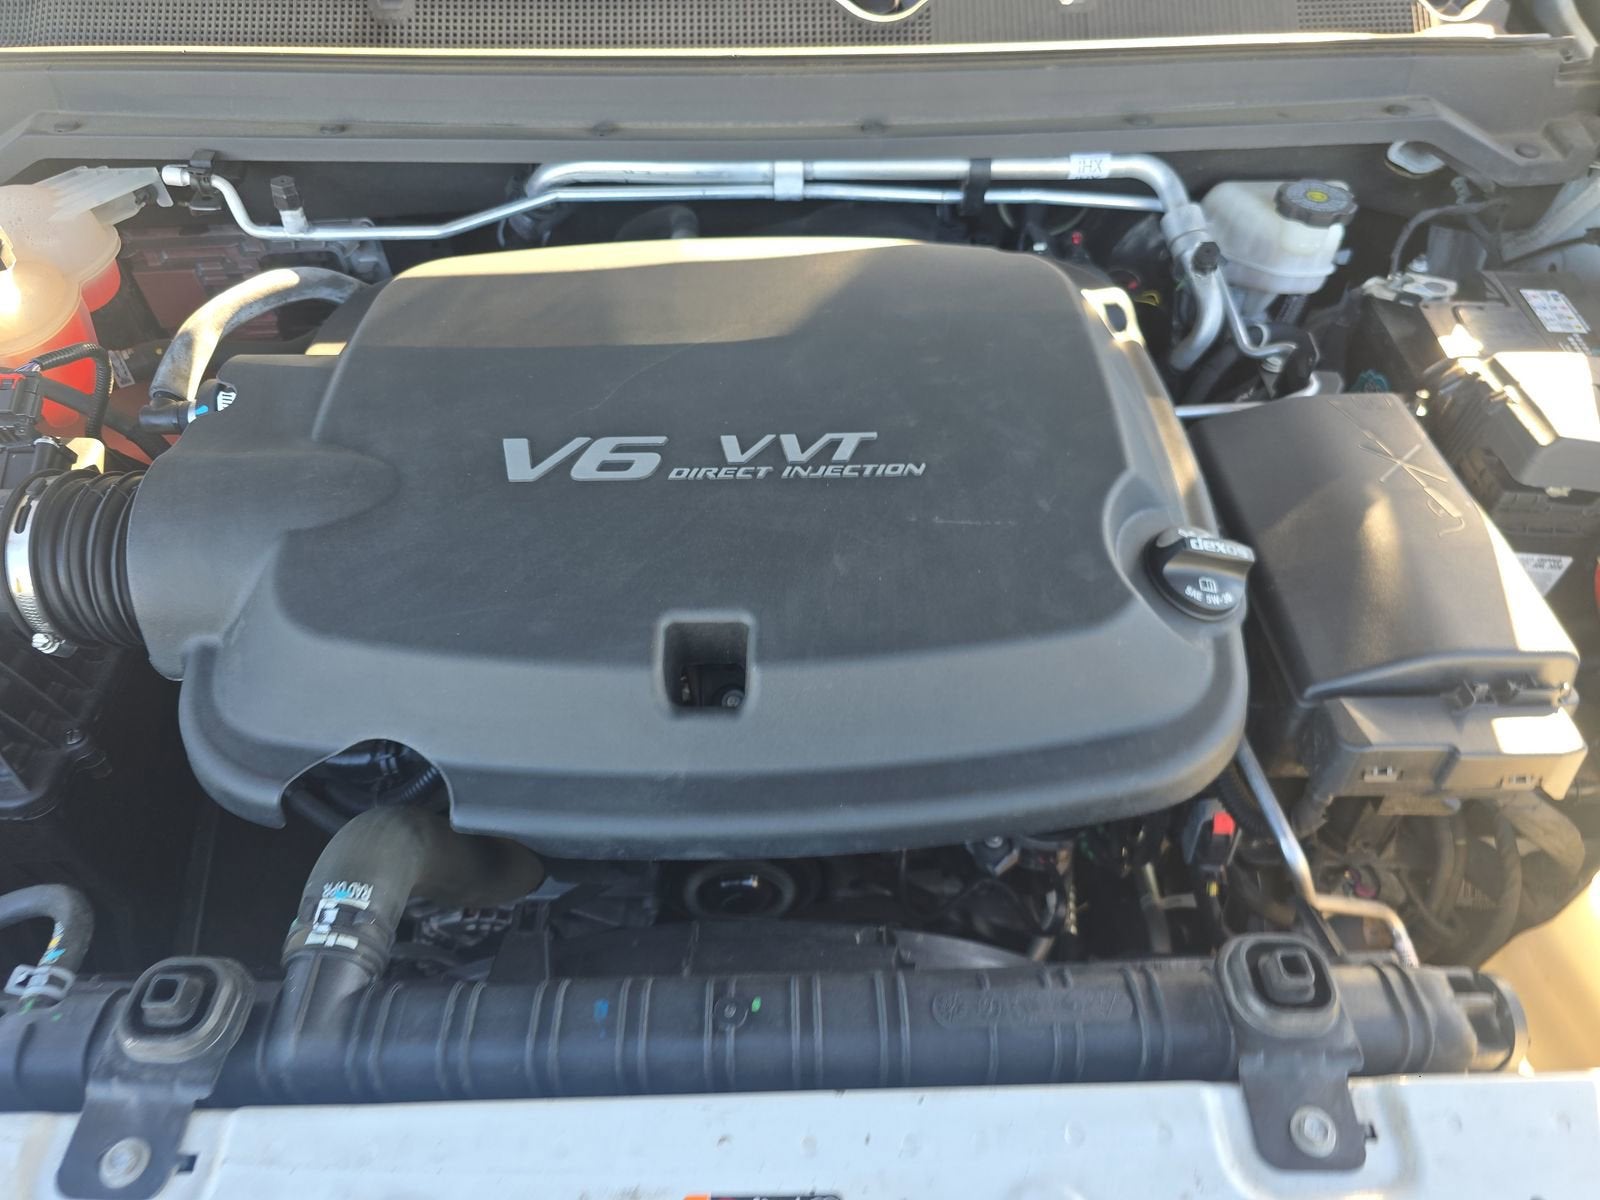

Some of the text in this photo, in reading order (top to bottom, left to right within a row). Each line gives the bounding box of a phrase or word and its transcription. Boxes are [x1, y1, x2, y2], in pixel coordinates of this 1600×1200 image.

[502, 431, 878, 482] V6 VVT
[667, 462, 927, 481] DIRECT INJECTION
